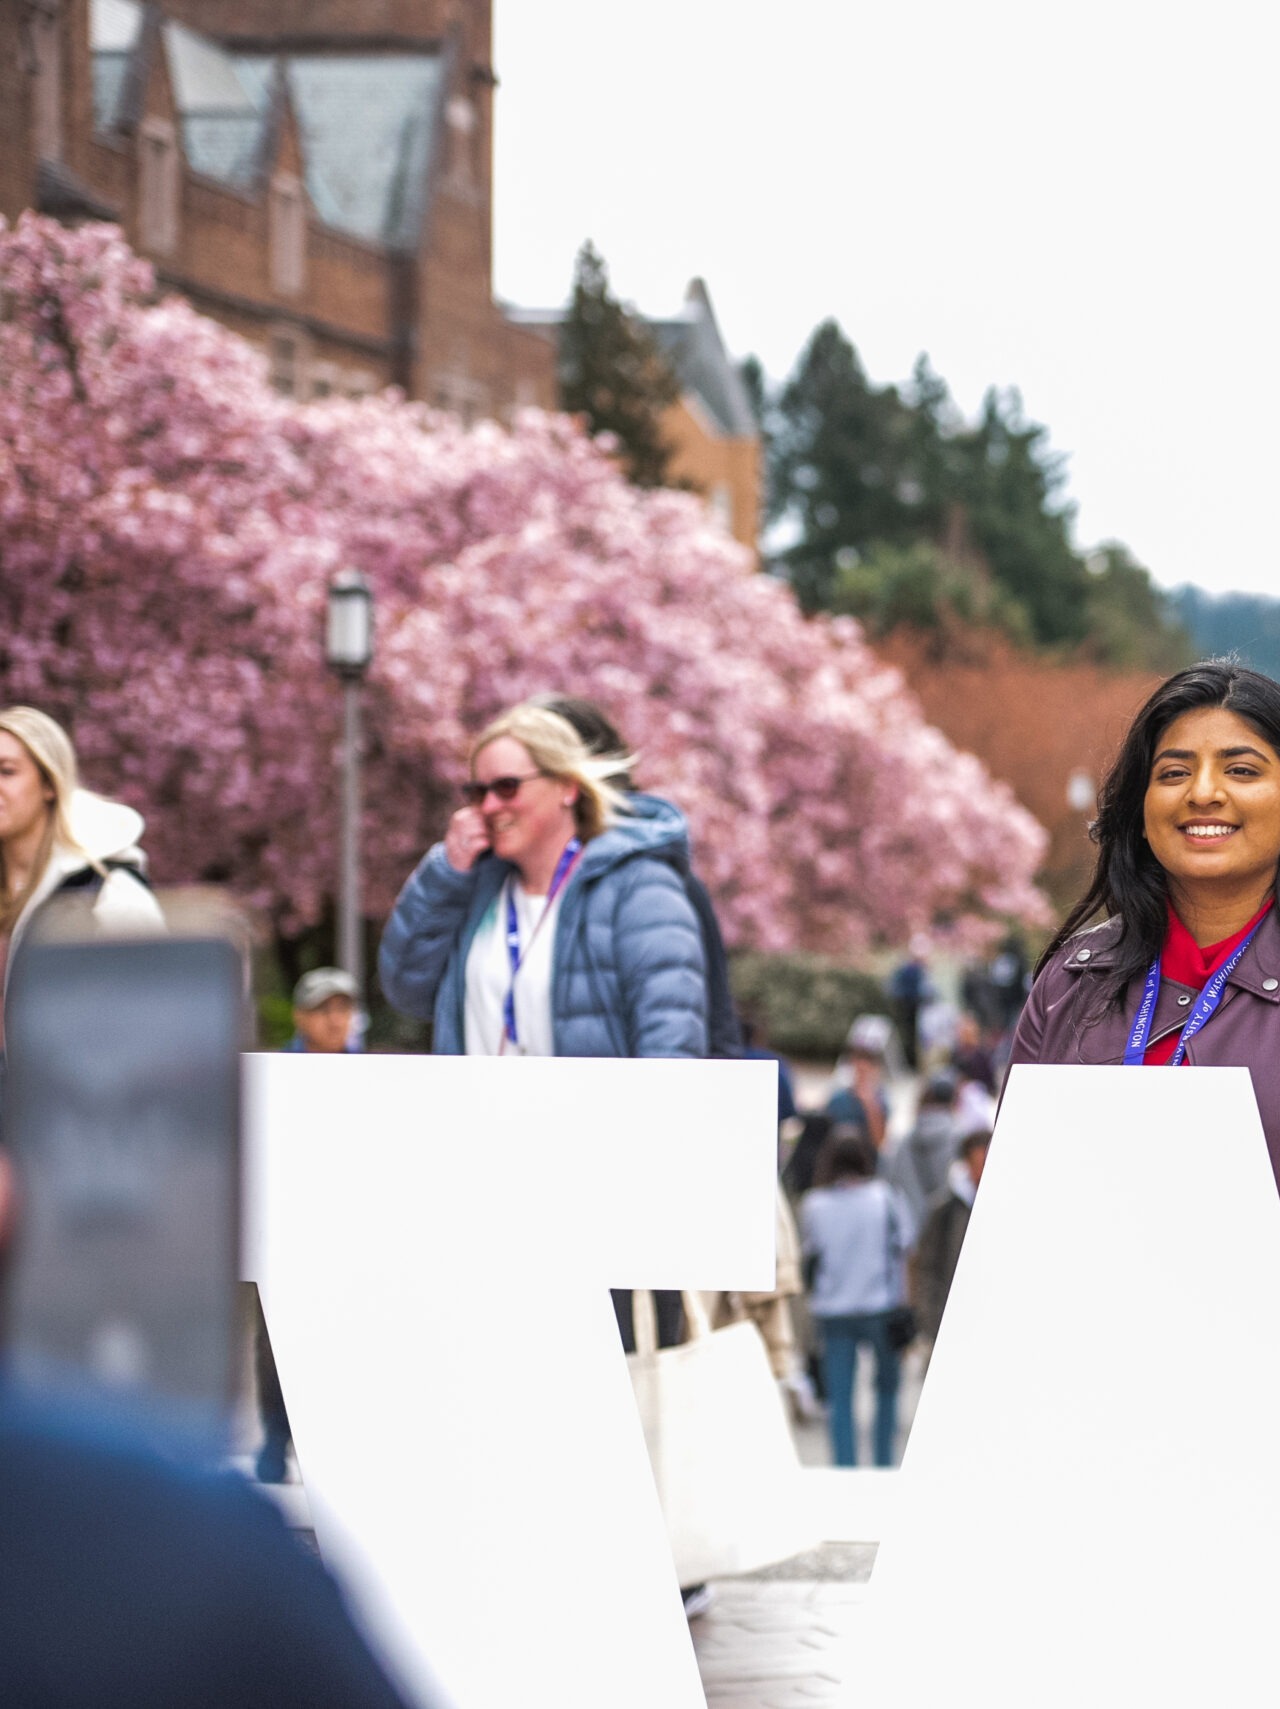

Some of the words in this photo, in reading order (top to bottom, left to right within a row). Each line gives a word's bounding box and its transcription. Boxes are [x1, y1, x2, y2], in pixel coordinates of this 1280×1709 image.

[1131, 990, 1155, 1048] WASHINGTON
[1172, 1012, 1204, 1066] NIVERSITY
[1202, 999, 1213, 1013] of
